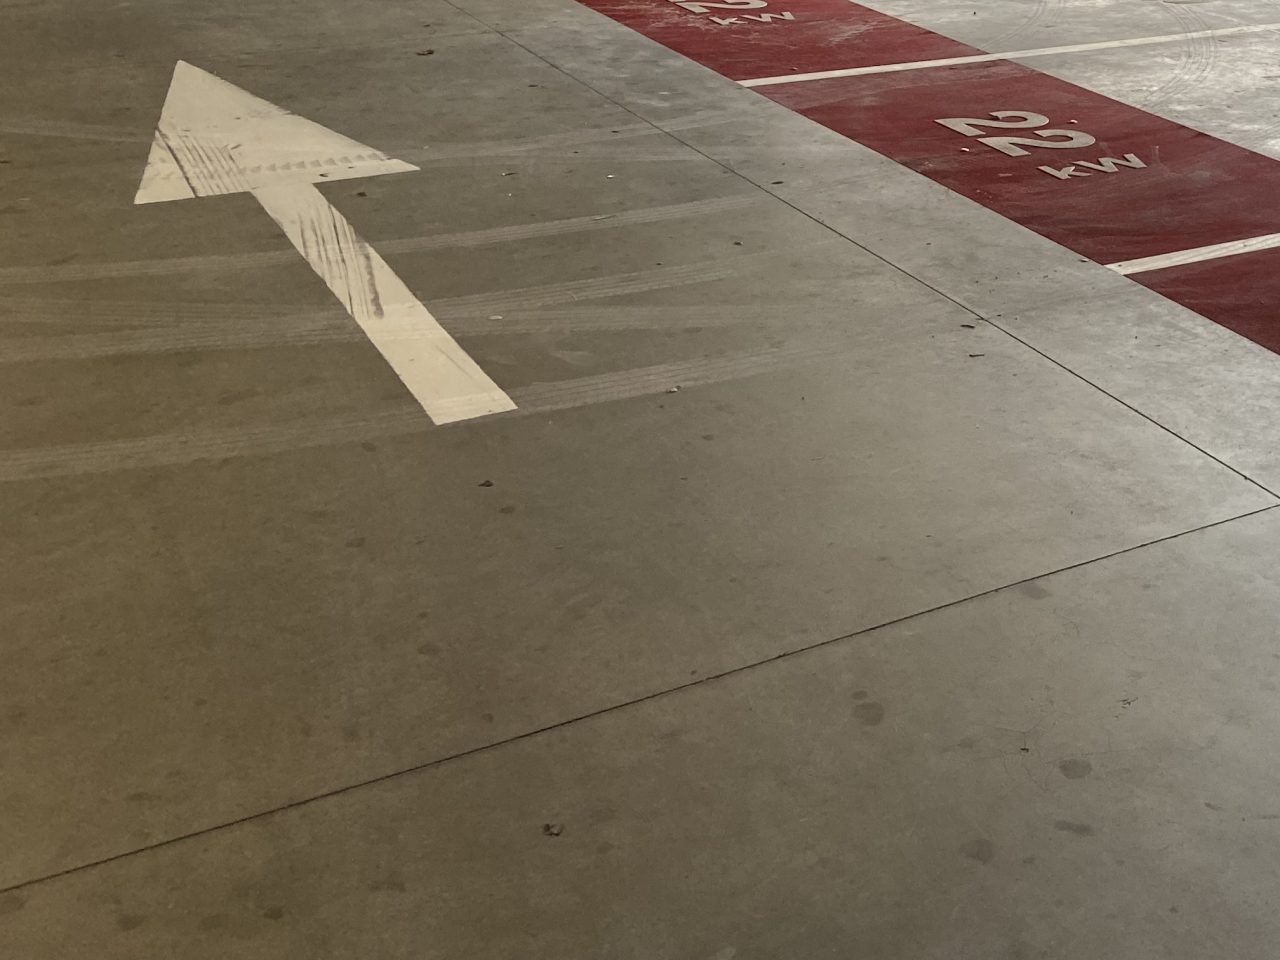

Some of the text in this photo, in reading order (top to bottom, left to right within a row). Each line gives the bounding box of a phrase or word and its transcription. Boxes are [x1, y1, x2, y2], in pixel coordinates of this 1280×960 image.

[709, 11, 796, 26] kW
[934, 110, 1096, 157] 22
[1036, 153, 1148, 180] kW
